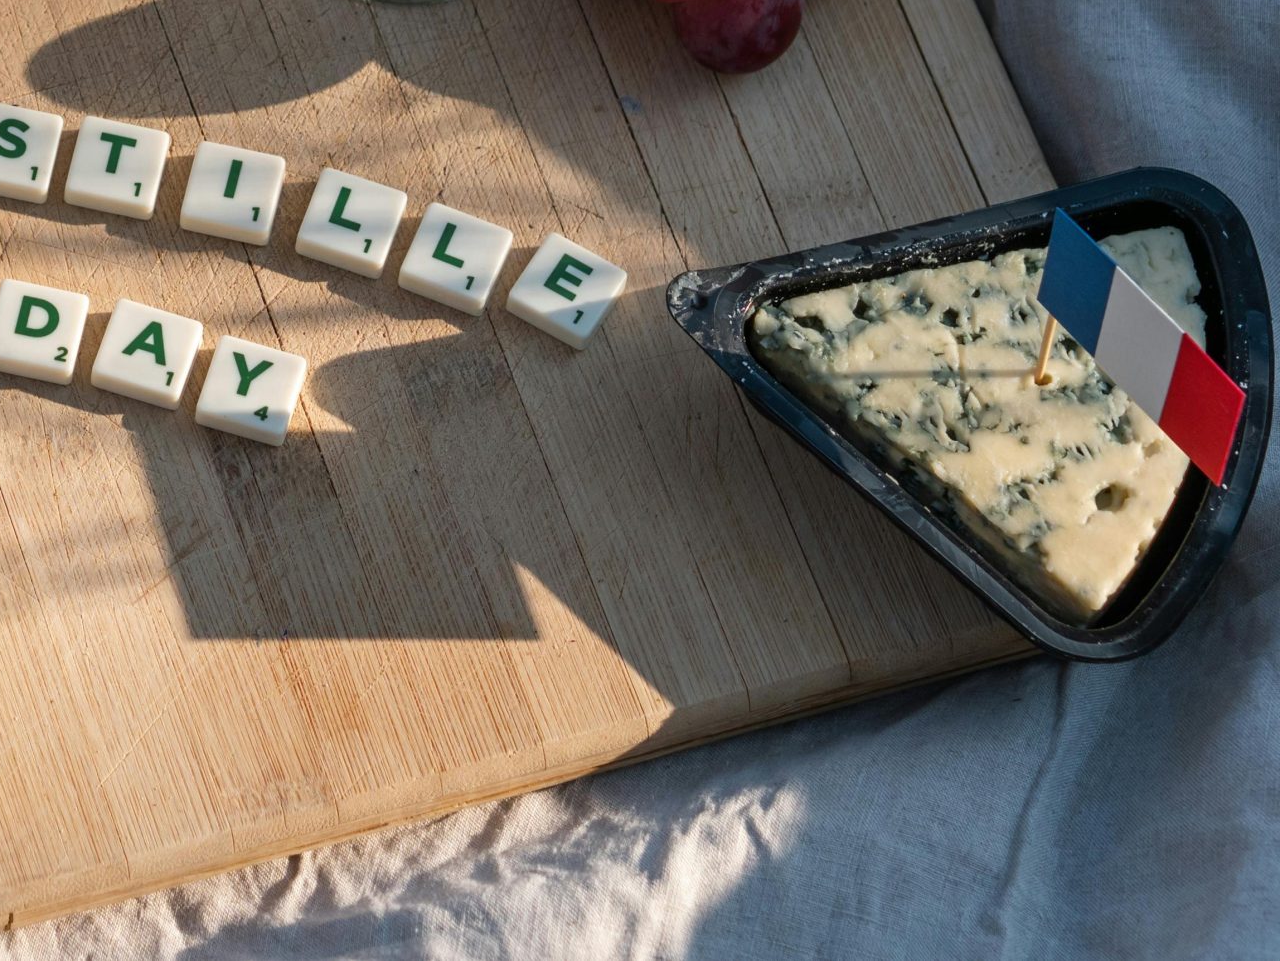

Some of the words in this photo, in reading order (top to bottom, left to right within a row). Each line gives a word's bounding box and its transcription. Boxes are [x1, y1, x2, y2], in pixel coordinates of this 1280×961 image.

[30, 166, 38, 181] 1
[133, 182, 142, 197] 1
[251, 206, 260, 222] 1
[363, 238, 372, 254] 1
[465, 275, 475, 291] 1
[573, 308, 585, 325] 1
[14, 295, 274, 397] DAY
[54, 346, 69, 363] 2
[165, 371, 174, 387] 1
[254, 406, 269, 422] 4
